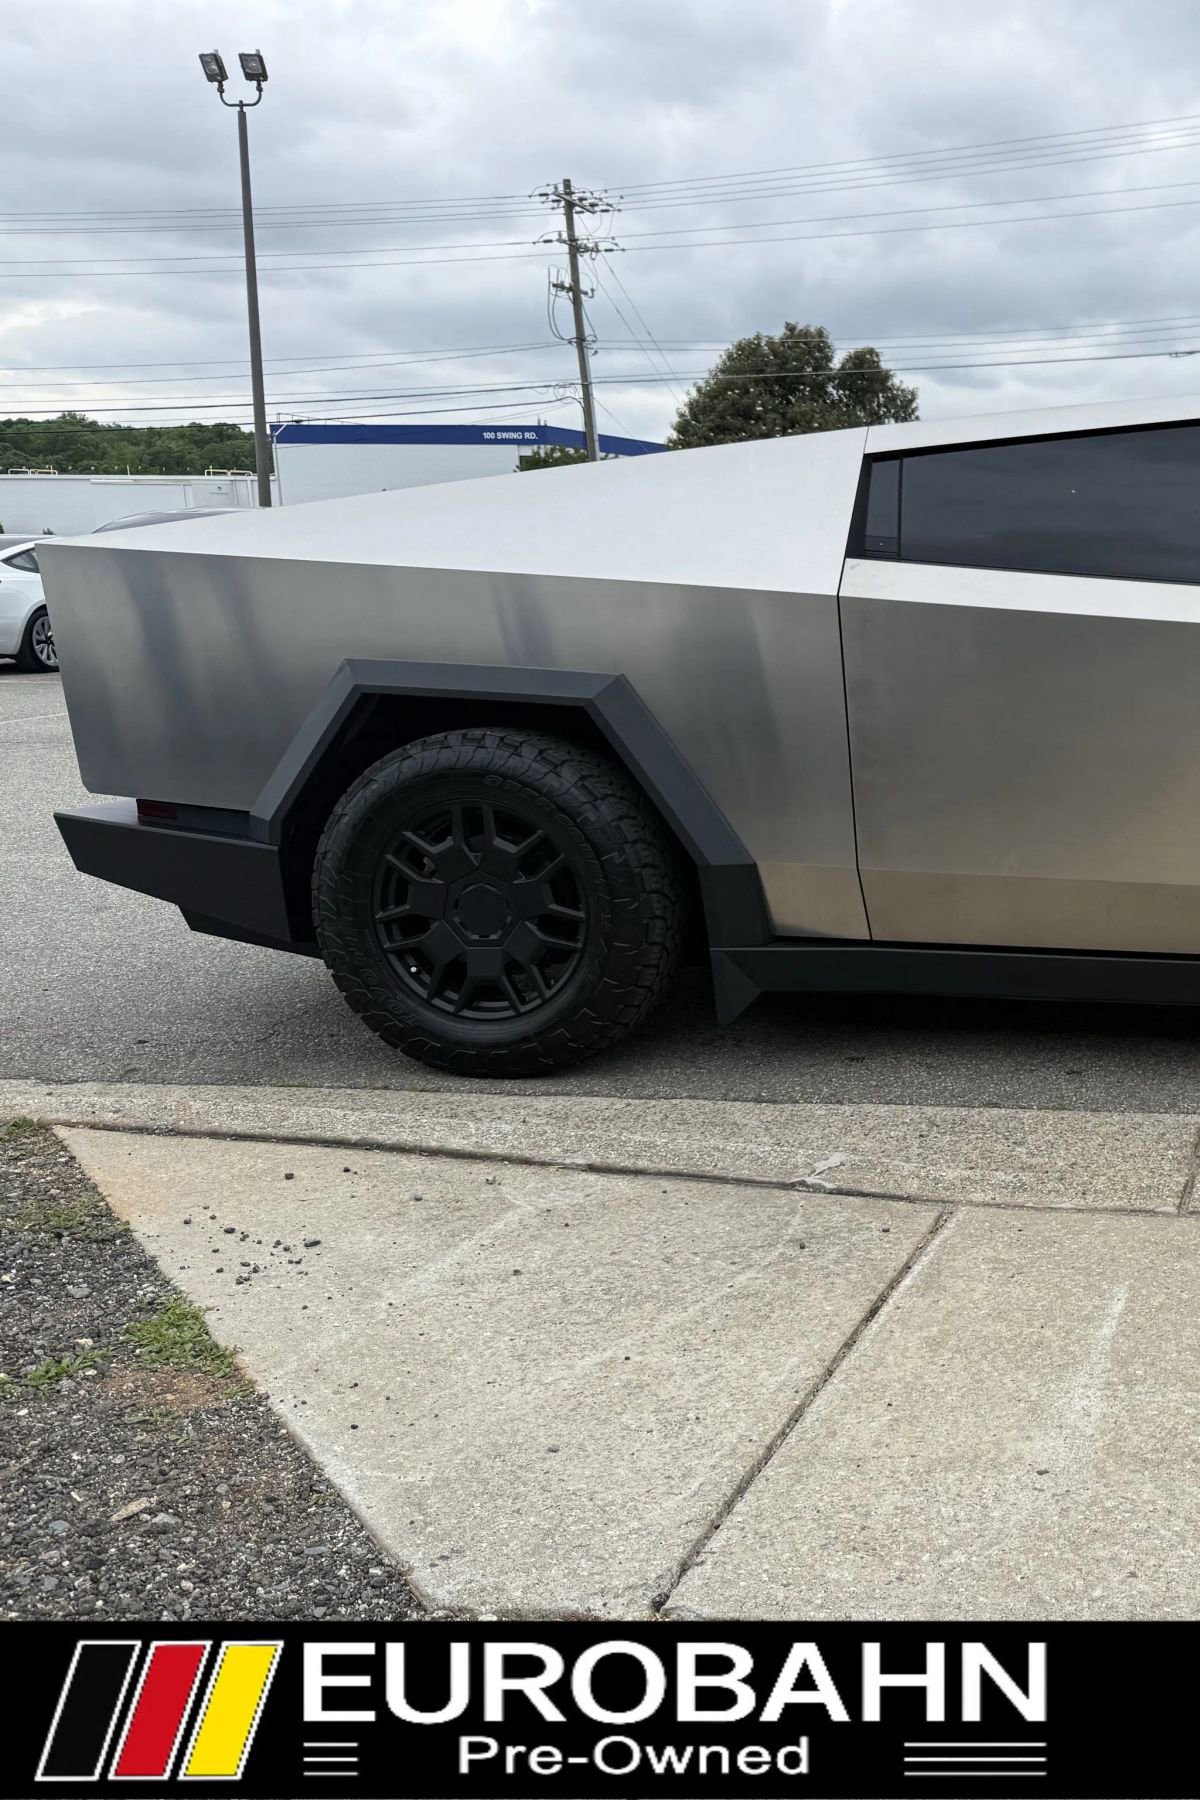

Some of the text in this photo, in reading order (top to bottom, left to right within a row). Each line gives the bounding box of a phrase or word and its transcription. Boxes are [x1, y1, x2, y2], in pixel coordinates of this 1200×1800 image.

[482, 431, 538, 440] 100 SWING RD.
